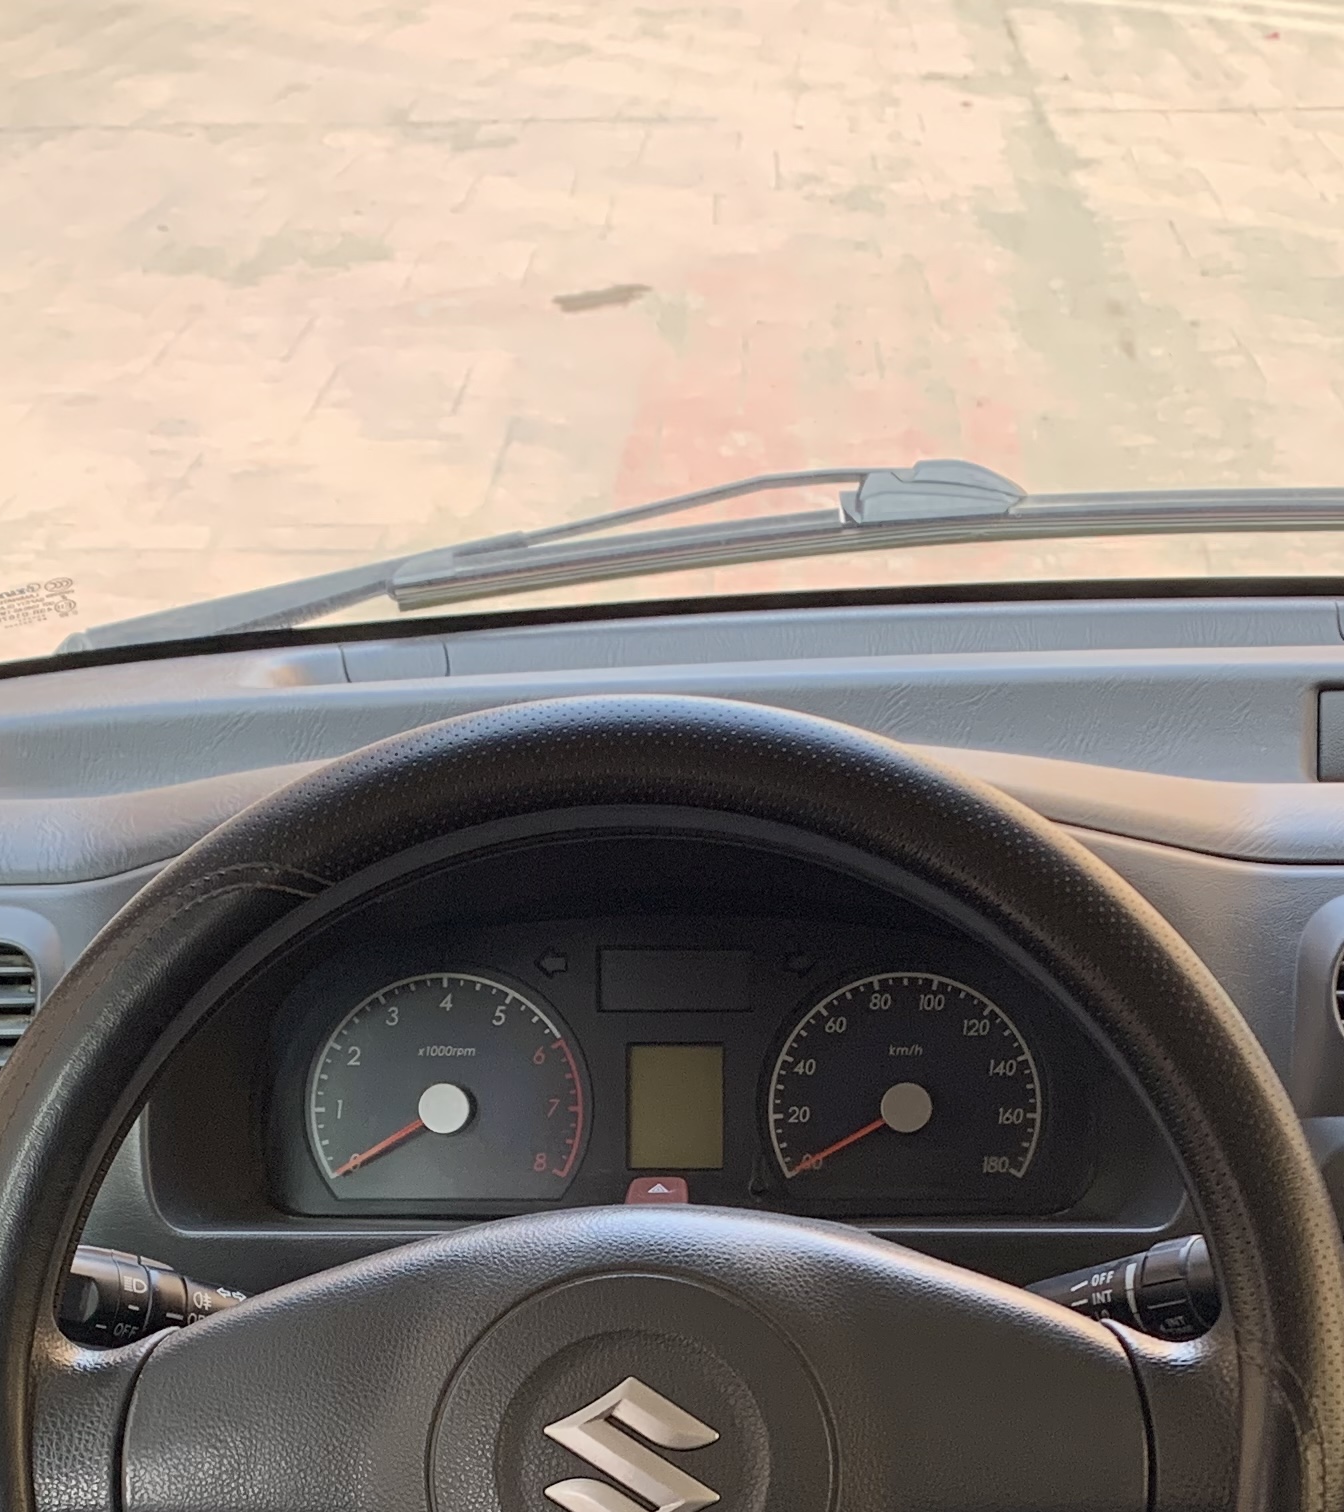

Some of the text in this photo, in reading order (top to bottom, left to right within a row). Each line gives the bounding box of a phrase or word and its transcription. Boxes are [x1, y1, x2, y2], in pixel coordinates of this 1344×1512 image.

[439, 993, 453, 1011] 4
[869, 993, 891, 1010] 80
[919, 993, 945, 1011] 100
[385, 1007, 399, 1026] 3
[492, 1006, 507, 1026] 5
[824, 1016, 847, 1034] 60
[962, 1019, 990, 1036] 120
[346, 1046, 361, 1066] 2
[417, 1045, 476, 1058] x1000rpm
[533, 1046, 546, 1064] 6
[888, 1044, 923, 1056] km/h
[793, 1059, 816, 1076] 40
[989, 1058, 1017, 1077] 140
[336, 1099, 343, 1119] 1
[548, 1098, 560, 1118] 7
[788, 1106, 810, 1123] 20
[998, 1107, 1024, 1125] 160
[533, 1152, 547, 1171] 8
[982, 1156, 1009, 1173] 180
[1091, 1270, 1115, 1287] OFF
[1092, 1289, 1113, 1306] INT
[113, 1322, 139, 1338] OFF
